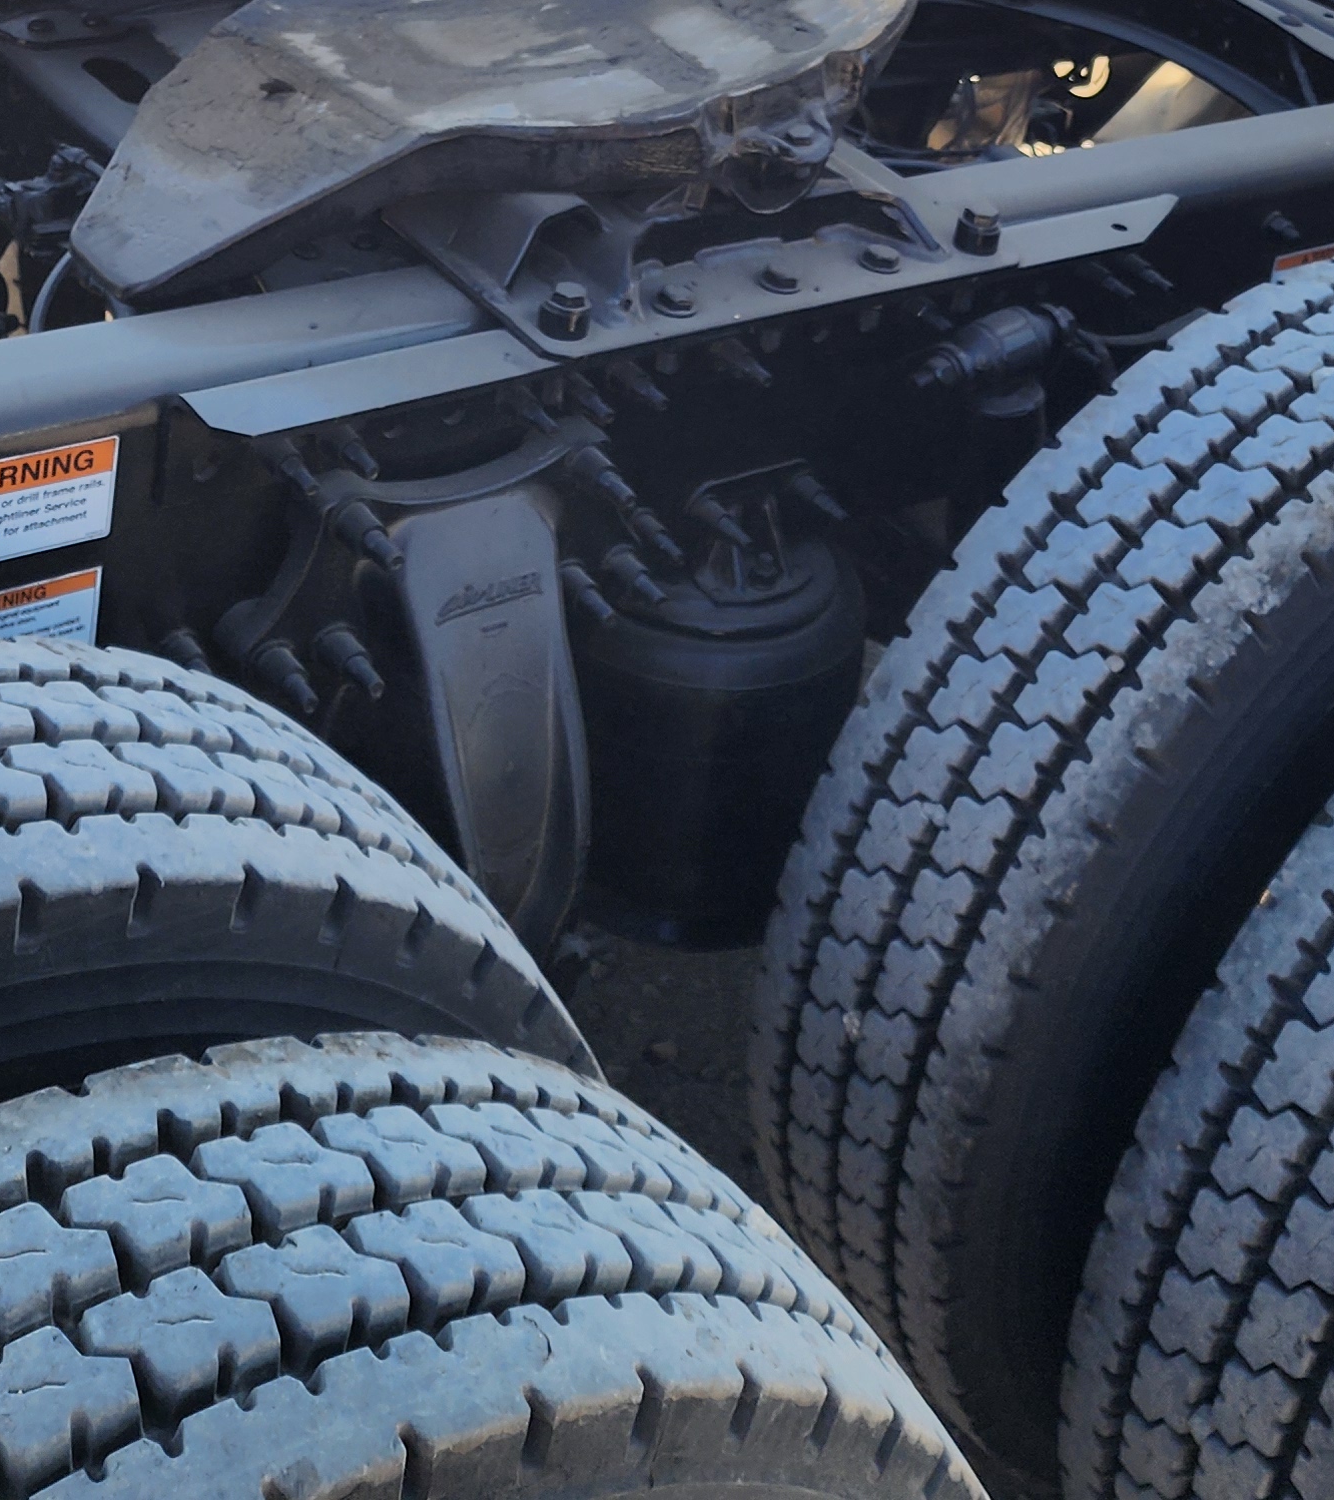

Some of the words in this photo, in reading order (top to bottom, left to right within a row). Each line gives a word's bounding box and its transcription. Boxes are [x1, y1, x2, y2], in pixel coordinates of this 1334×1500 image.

[1, 498, 14, 508] or
[17, 491, 40, 505] drill
[43, 485, 76, 499] frame
[78, 479, 106, 492] rails.
[44, 497, 87, 513] Service
[3, 525, 20, 538] for
[22, 510, 88, 532] attachment
